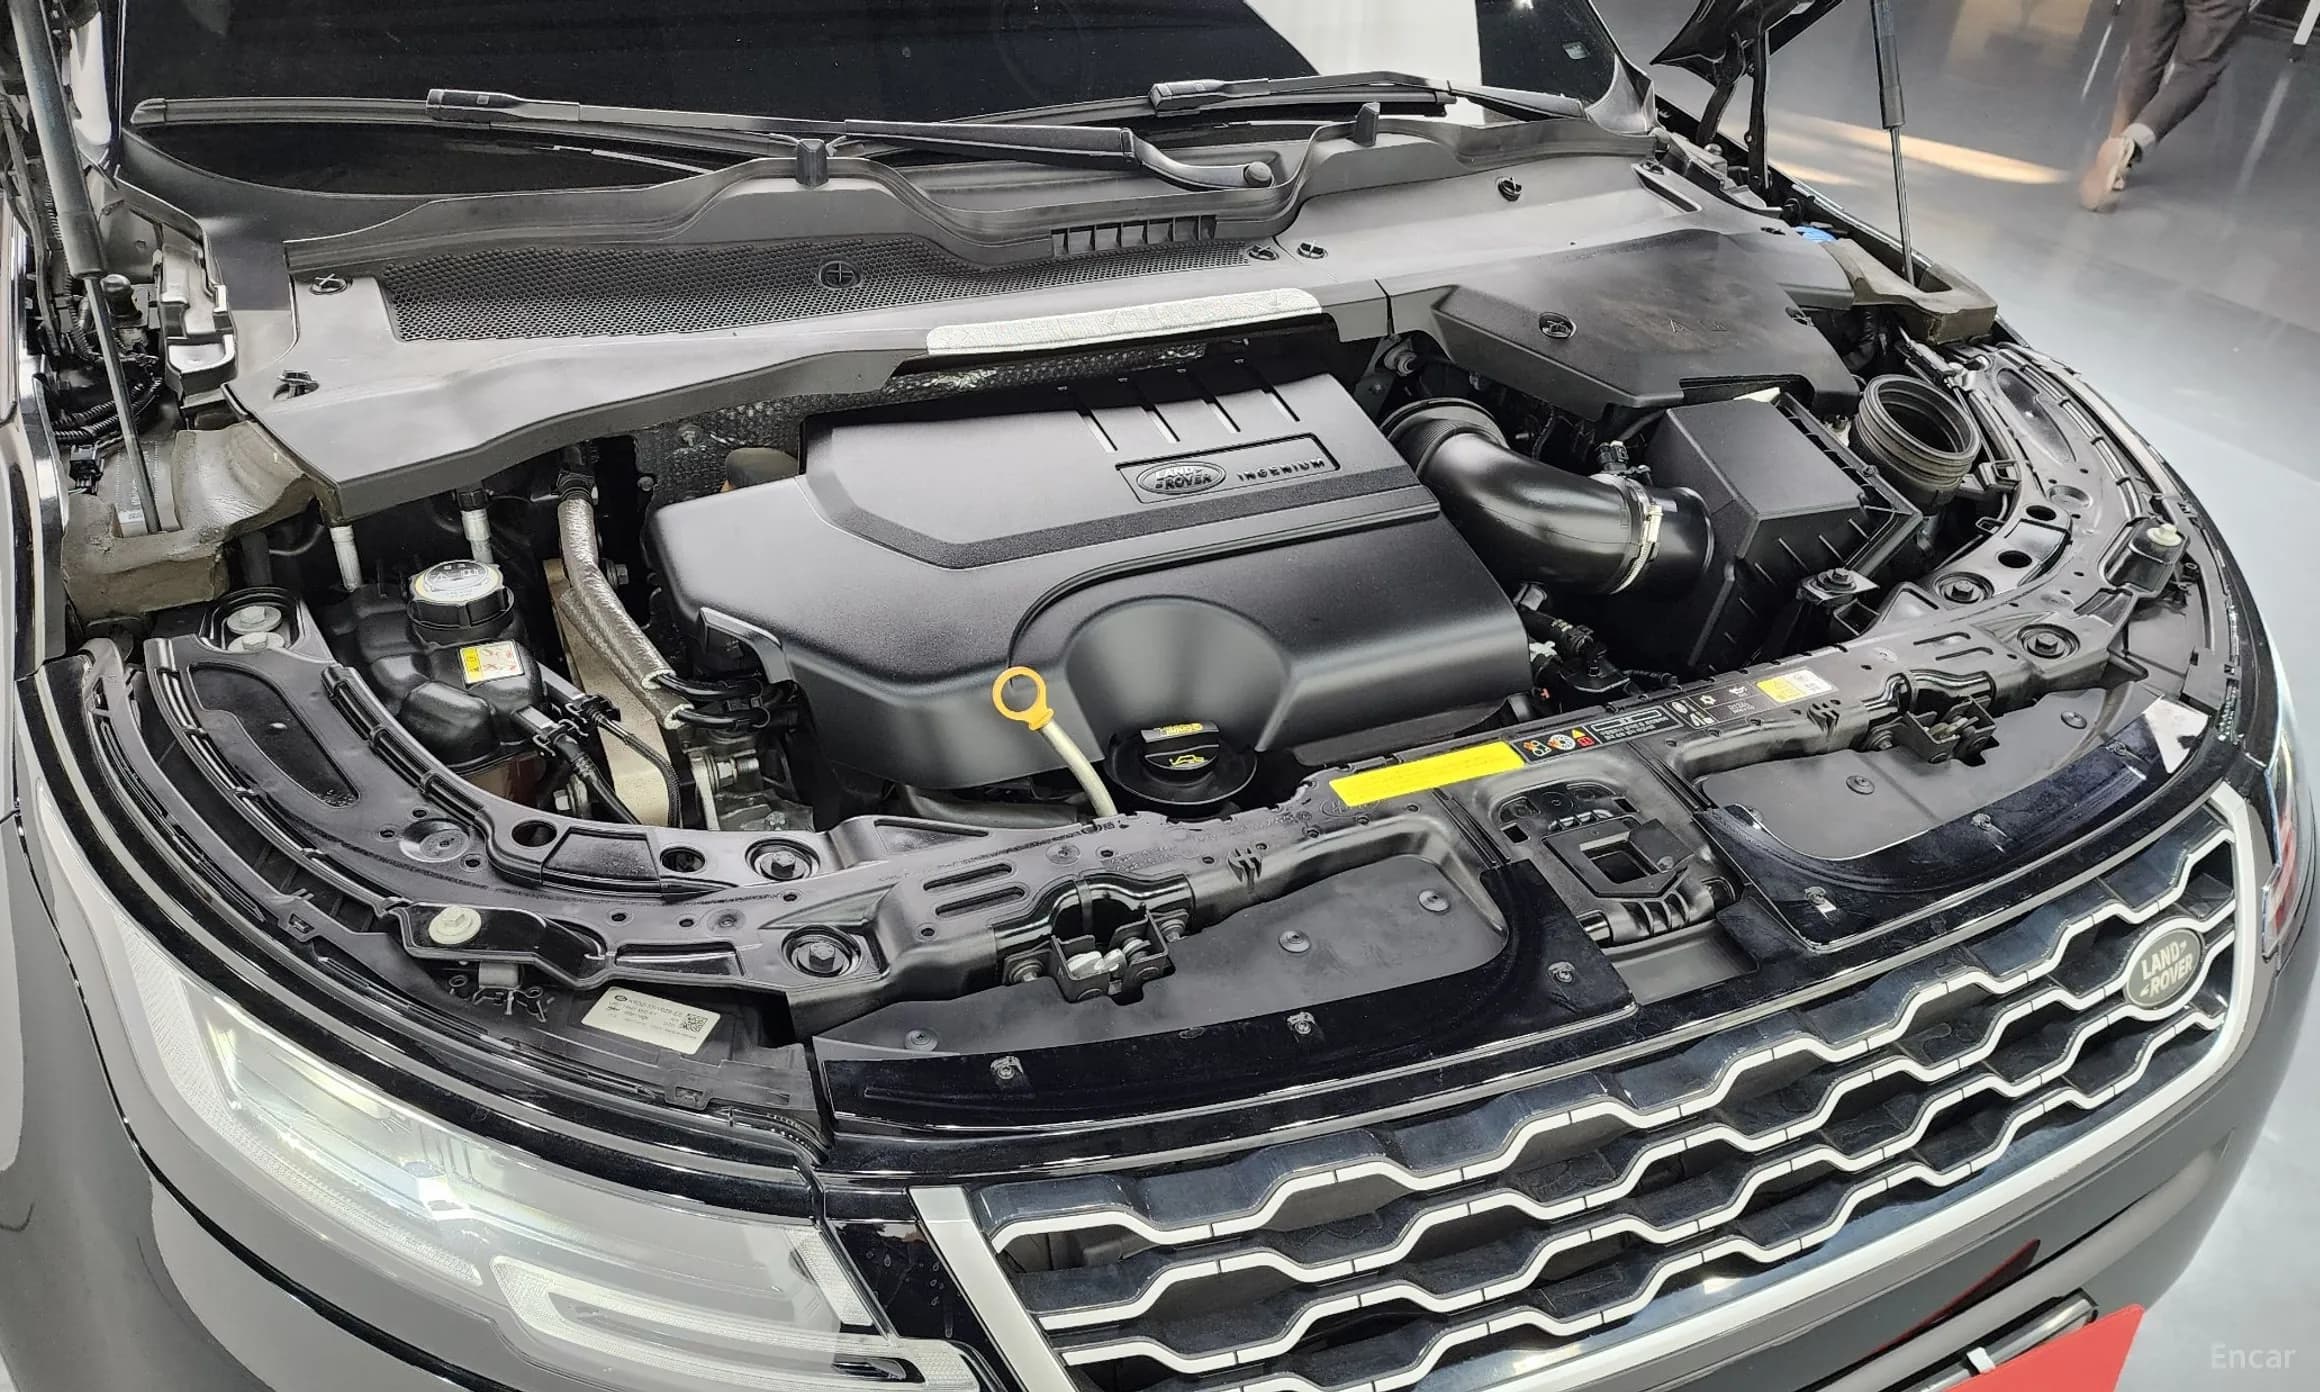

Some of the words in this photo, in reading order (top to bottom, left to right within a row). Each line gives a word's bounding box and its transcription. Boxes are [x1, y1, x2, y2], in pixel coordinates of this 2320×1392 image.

[1155, 466, 1196, 482] LAND
[1238, 457, 1326, 482] INGENIUM
[2141, 940, 2180, 980] LAND
[2149, 953, 2194, 998] ROVER
